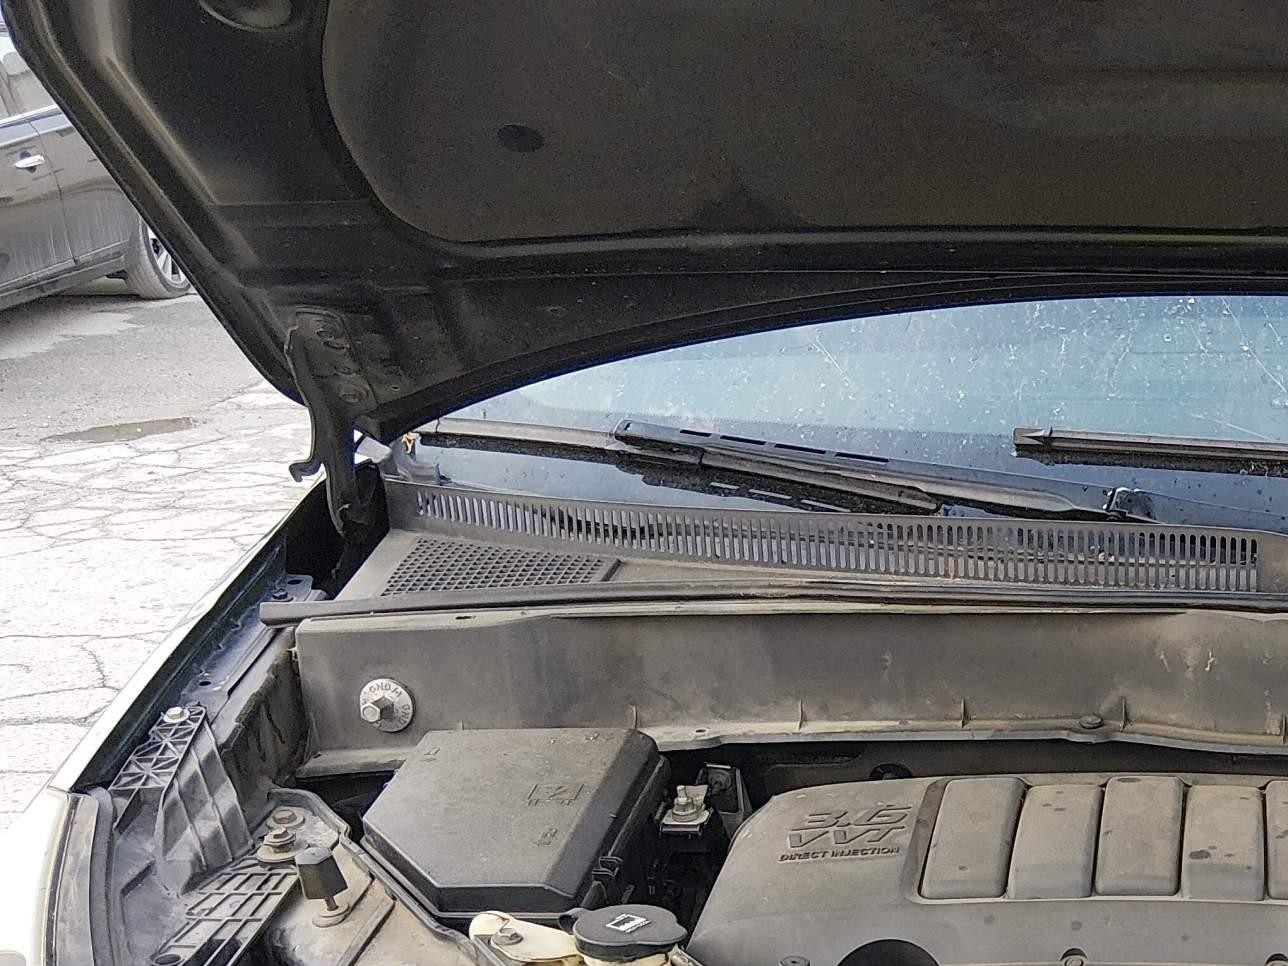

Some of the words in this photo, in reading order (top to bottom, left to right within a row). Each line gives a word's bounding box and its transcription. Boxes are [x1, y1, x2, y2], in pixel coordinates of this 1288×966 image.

[790, 804, 912, 832] 3.6
[788, 826, 905, 849] VVT
[779, 850, 829, 862] DIRECT
[831, 846, 900, 858] INJECTION
